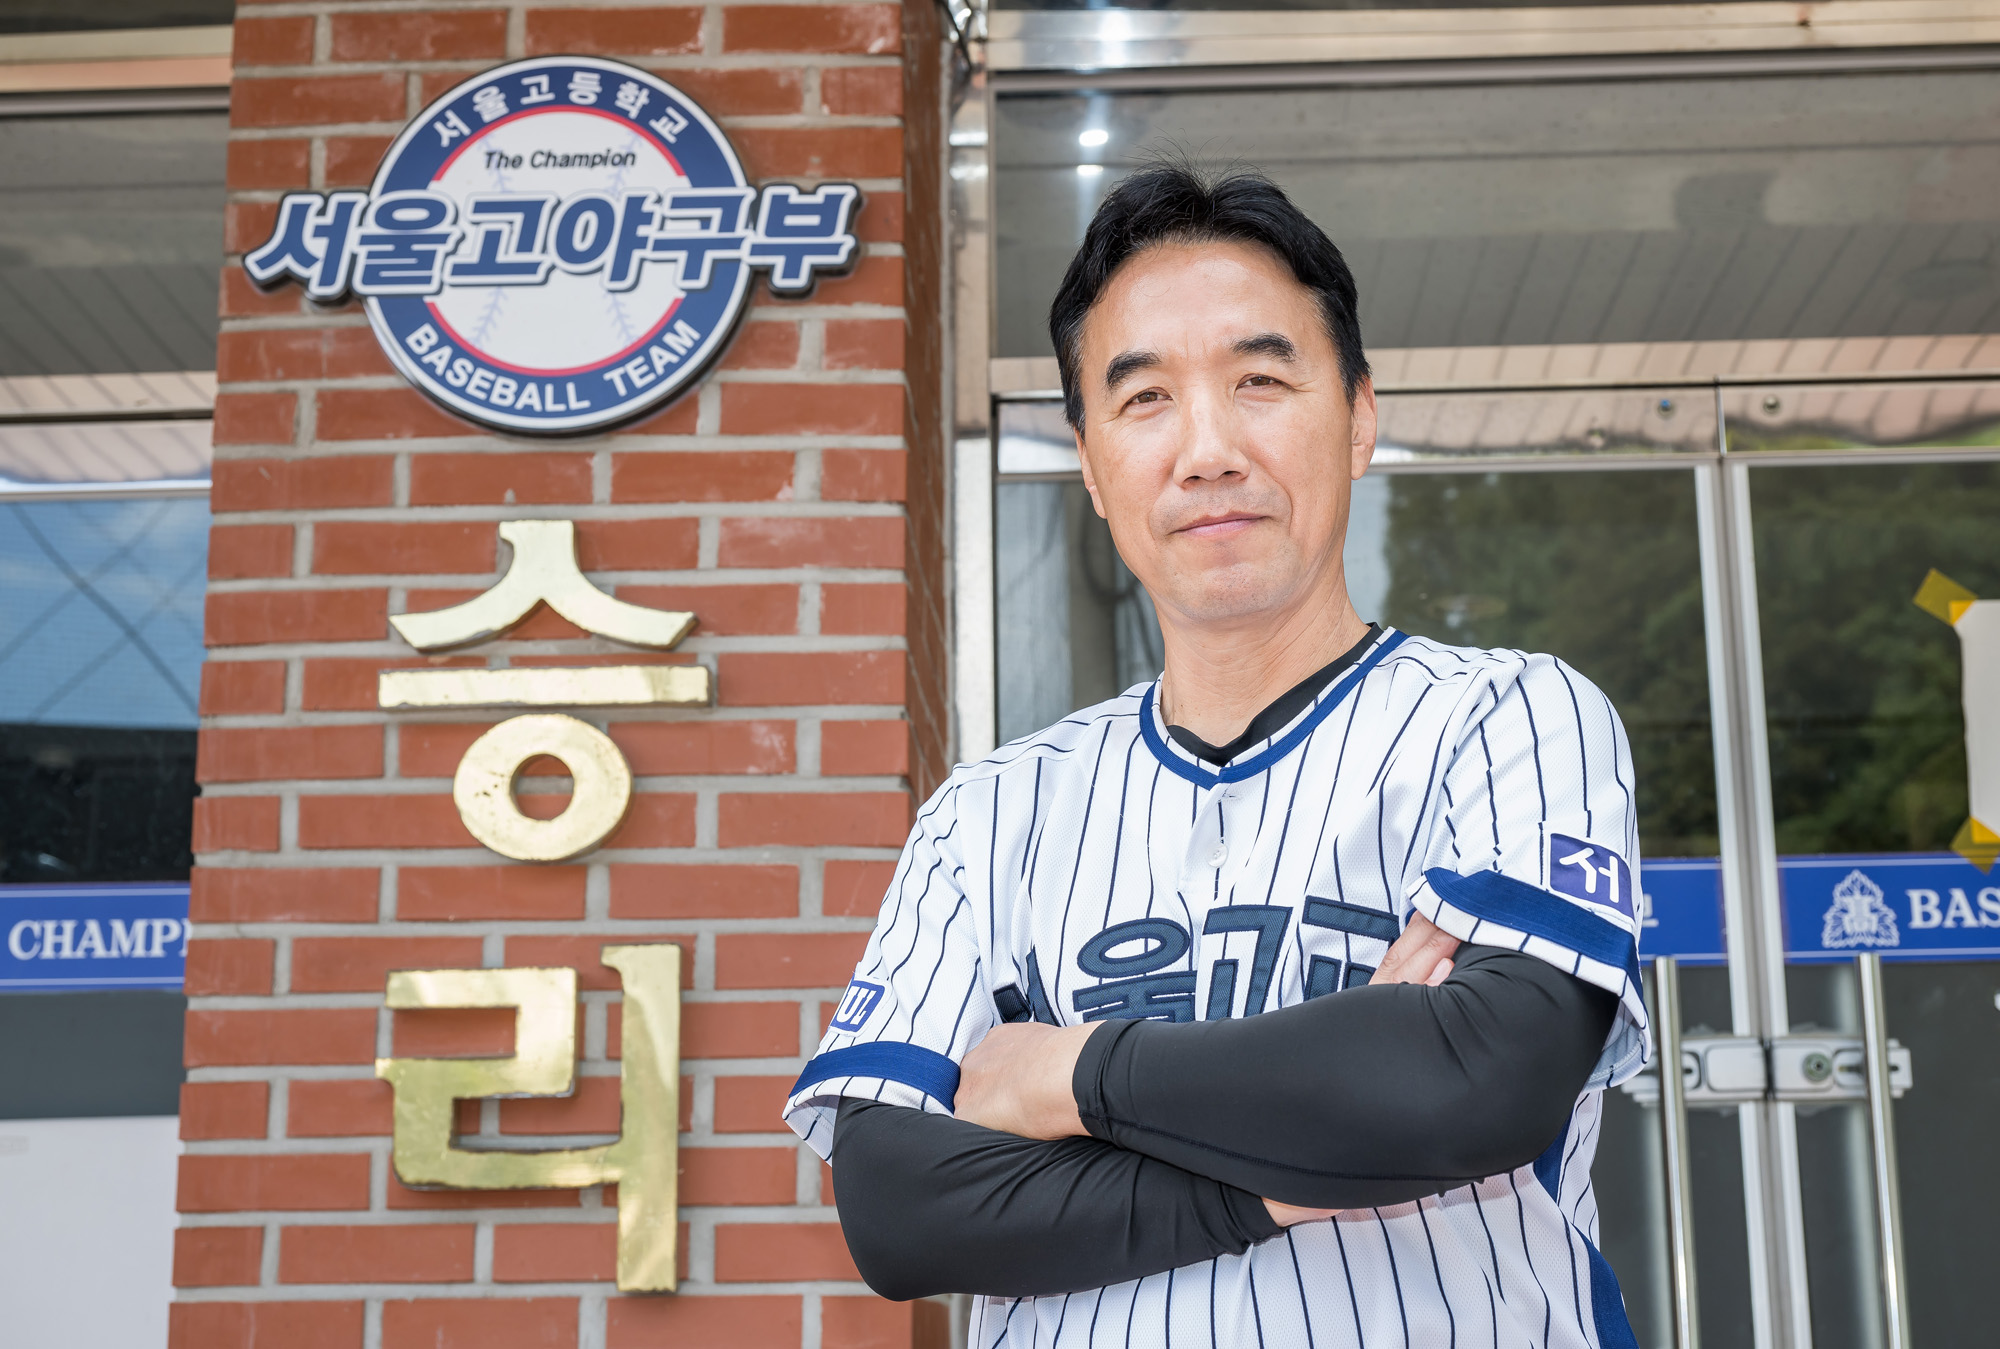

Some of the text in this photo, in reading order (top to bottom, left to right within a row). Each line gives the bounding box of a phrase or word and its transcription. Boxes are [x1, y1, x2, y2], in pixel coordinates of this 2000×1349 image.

[434, 71, 689, 147] 서울고등학교
[484, 149, 636, 170] The Champion
[244, 184, 859, 297] 서울고야구부
[405, 318, 701, 412] BASEBALL TEAM
